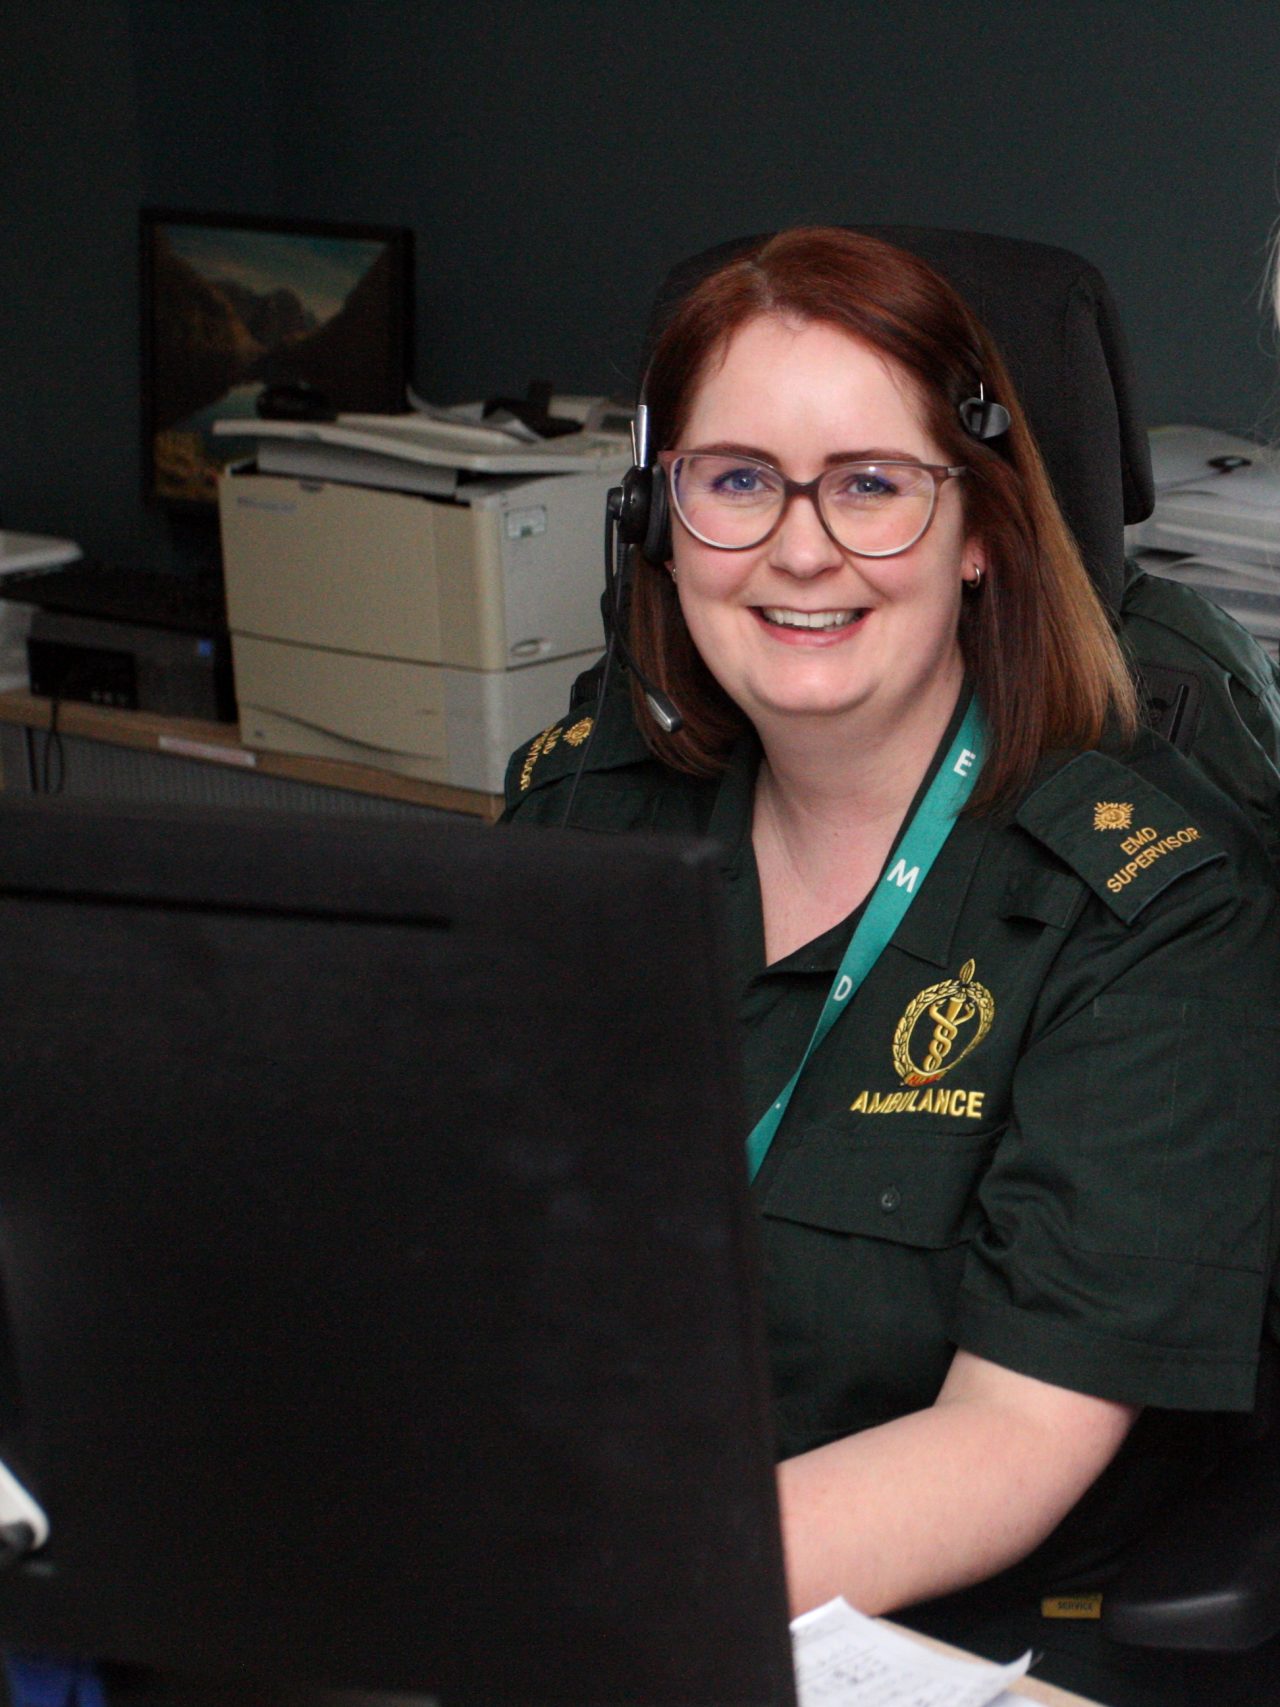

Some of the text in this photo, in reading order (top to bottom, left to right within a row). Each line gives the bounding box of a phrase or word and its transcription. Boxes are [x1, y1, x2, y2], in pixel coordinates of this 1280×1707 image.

[1120, 827, 1157, 855] EMD
[1106, 827, 1200, 892] SUPERVISOR
[850, 1088, 985, 1119] AMBULANCE
